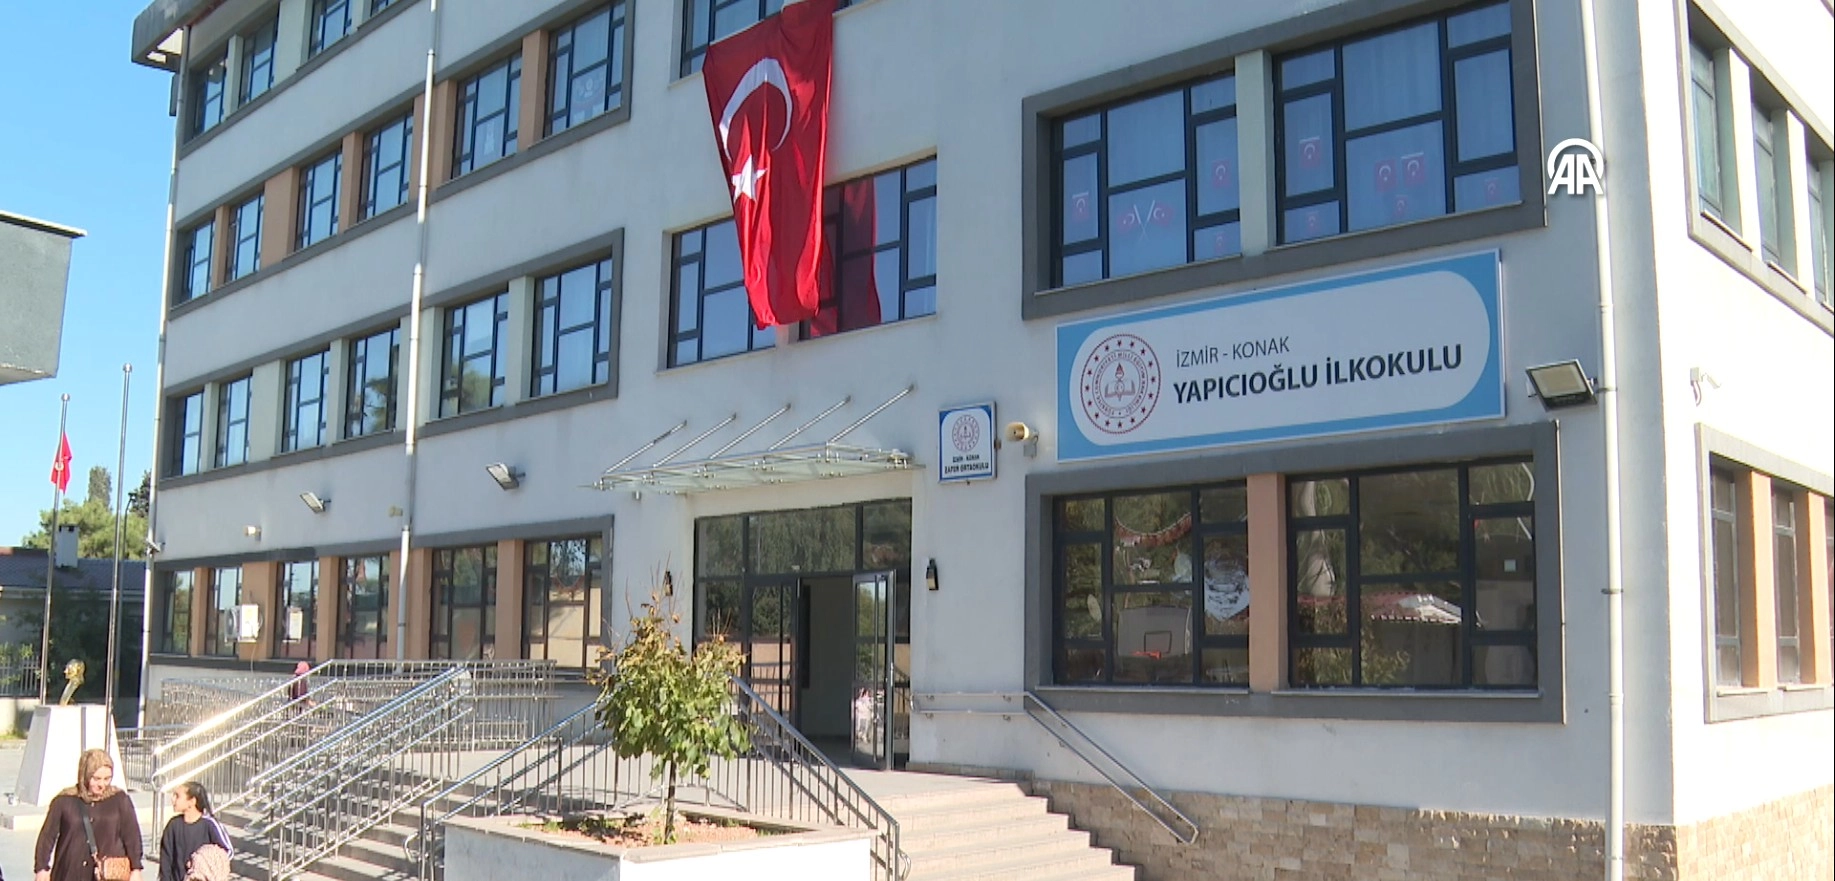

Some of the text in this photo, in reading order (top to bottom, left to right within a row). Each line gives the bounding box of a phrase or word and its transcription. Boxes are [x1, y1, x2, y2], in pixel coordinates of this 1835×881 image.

[1173, 362, 1318, 404] YAPICIOĞLU
[1326, 343, 1462, 385] İLKOKULU
[1176, 345, 1219, 368] İZMİR
[1232, 336, 1290, 360] KONAK
